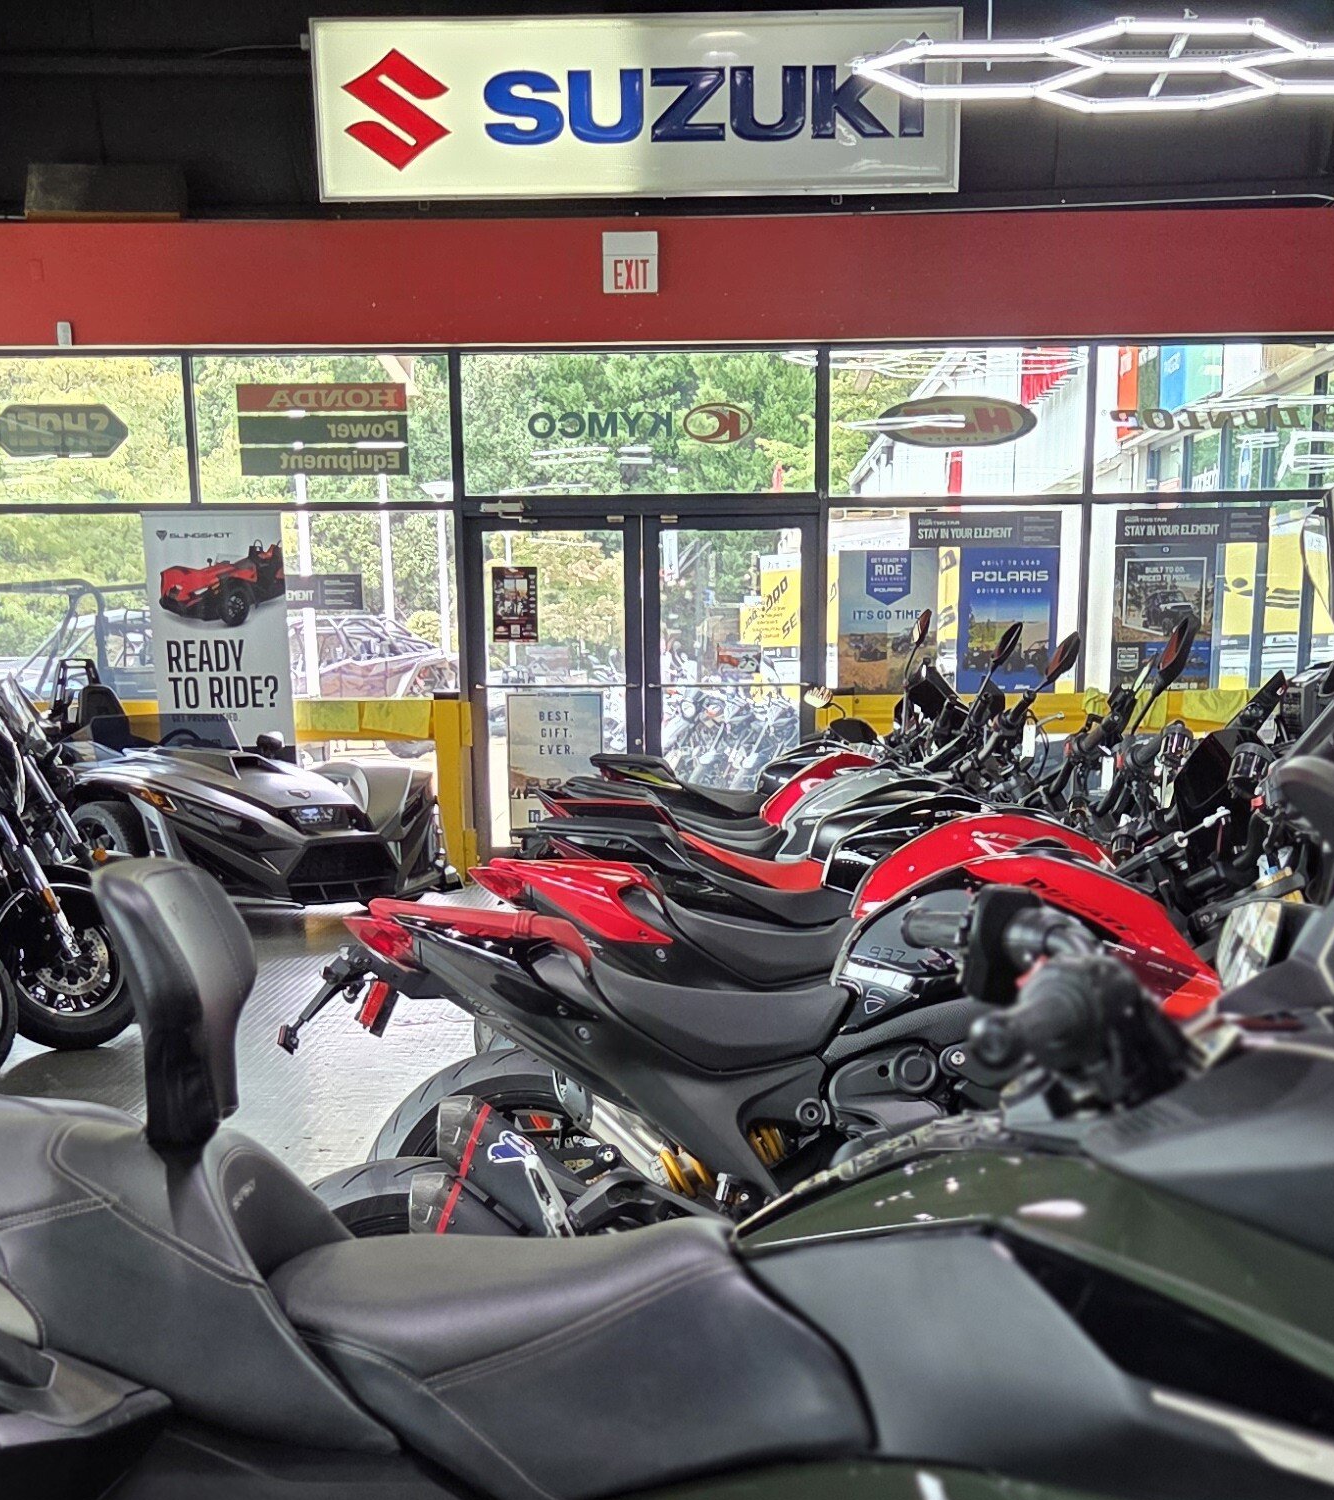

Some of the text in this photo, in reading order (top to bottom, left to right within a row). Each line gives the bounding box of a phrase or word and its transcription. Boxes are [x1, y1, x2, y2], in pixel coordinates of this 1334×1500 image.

[483, 62, 925, 145] SUZUKI
[613, 259, 650, 290] EXIT
[917, 528, 938, 539] STAY
[940, 528, 949, 539] IN
[950, 528, 973, 539] YOUR
[973, 527, 1013, 538] ELEMENT
[1124, 525, 1146, 537] STAY
[1147, 525, 1156, 536] IN
[1157, 524, 1180, 536] YOUR
[1180, 523, 1220, 535] ELEMENT
[874, 564, 903, 576] RIDE
[971, 570, 1049, 582] POLARIS
[285, 589, 314, 602] EMENT
[853, 609, 922, 620] IT'S GO TIME
[166, 639, 244, 673] READY
[168, 675, 279, 709] TO RIDE?
[538, 710, 574, 722] BEST.
[540, 727, 573, 738] GIFT.
[539, 744, 575, 755] EVER.
[1021, 877, 1129, 934] DUCATI
[869, 944, 906, 961] 937
